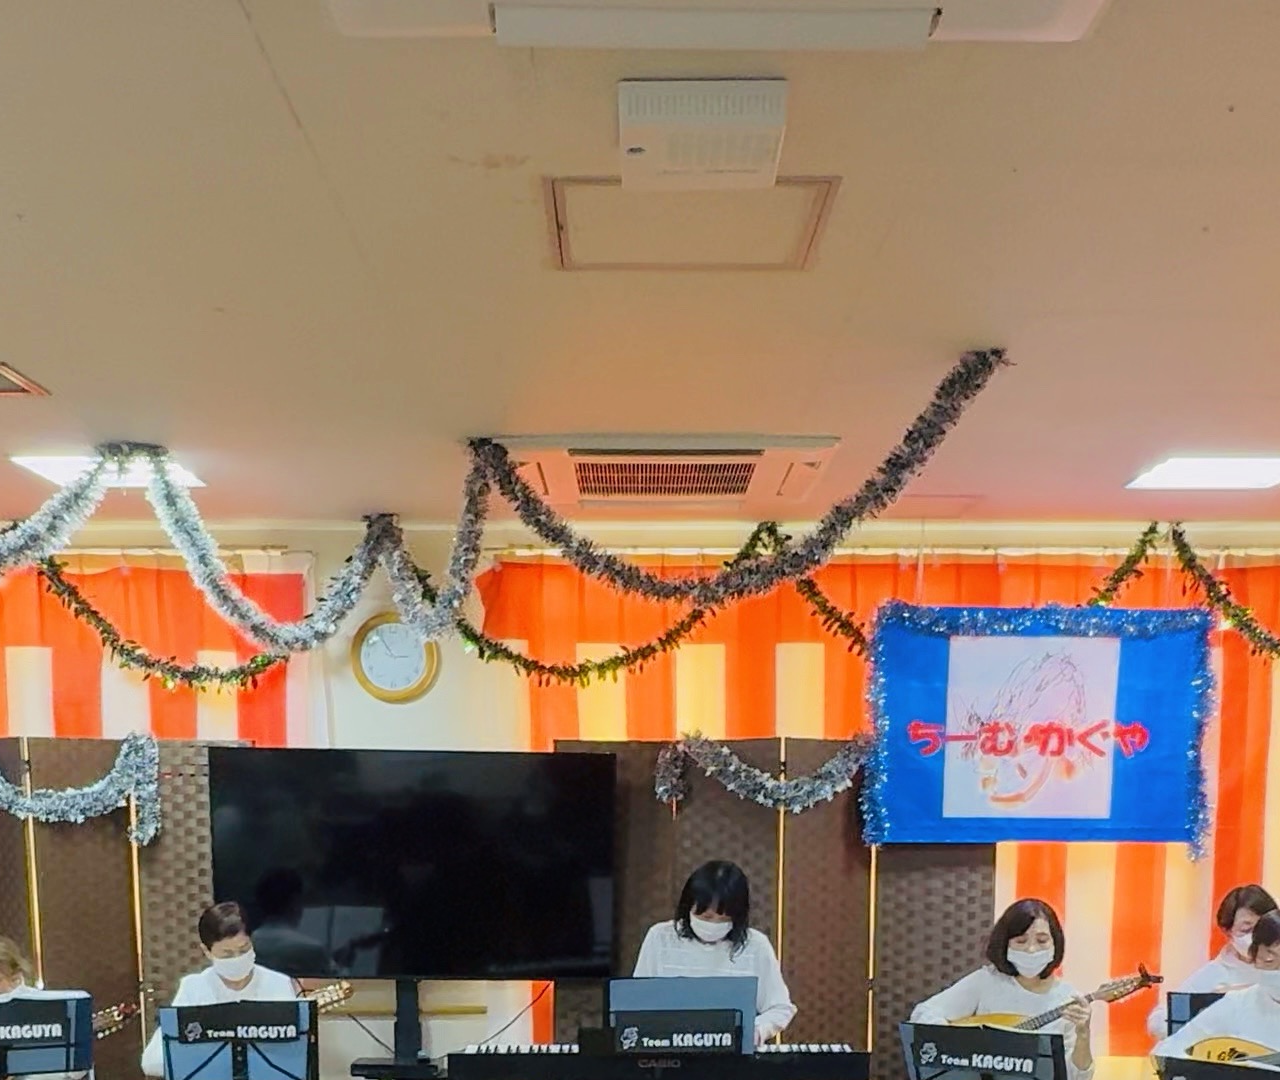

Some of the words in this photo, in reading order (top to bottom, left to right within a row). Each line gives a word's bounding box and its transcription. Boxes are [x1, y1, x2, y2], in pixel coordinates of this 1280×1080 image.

[0, 1023, 62, 1039] KAGUYA
[206, 1029, 236, 1039] Team
[236, 1025, 297, 1039] KAGUYA
[641, 1036, 670, 1047] Team
[672, 1032, 732, 1047] KAGUYA
[941, 1054, 970, 1066] Team
[971, 1053, 1034, 1074] KAGUYA
